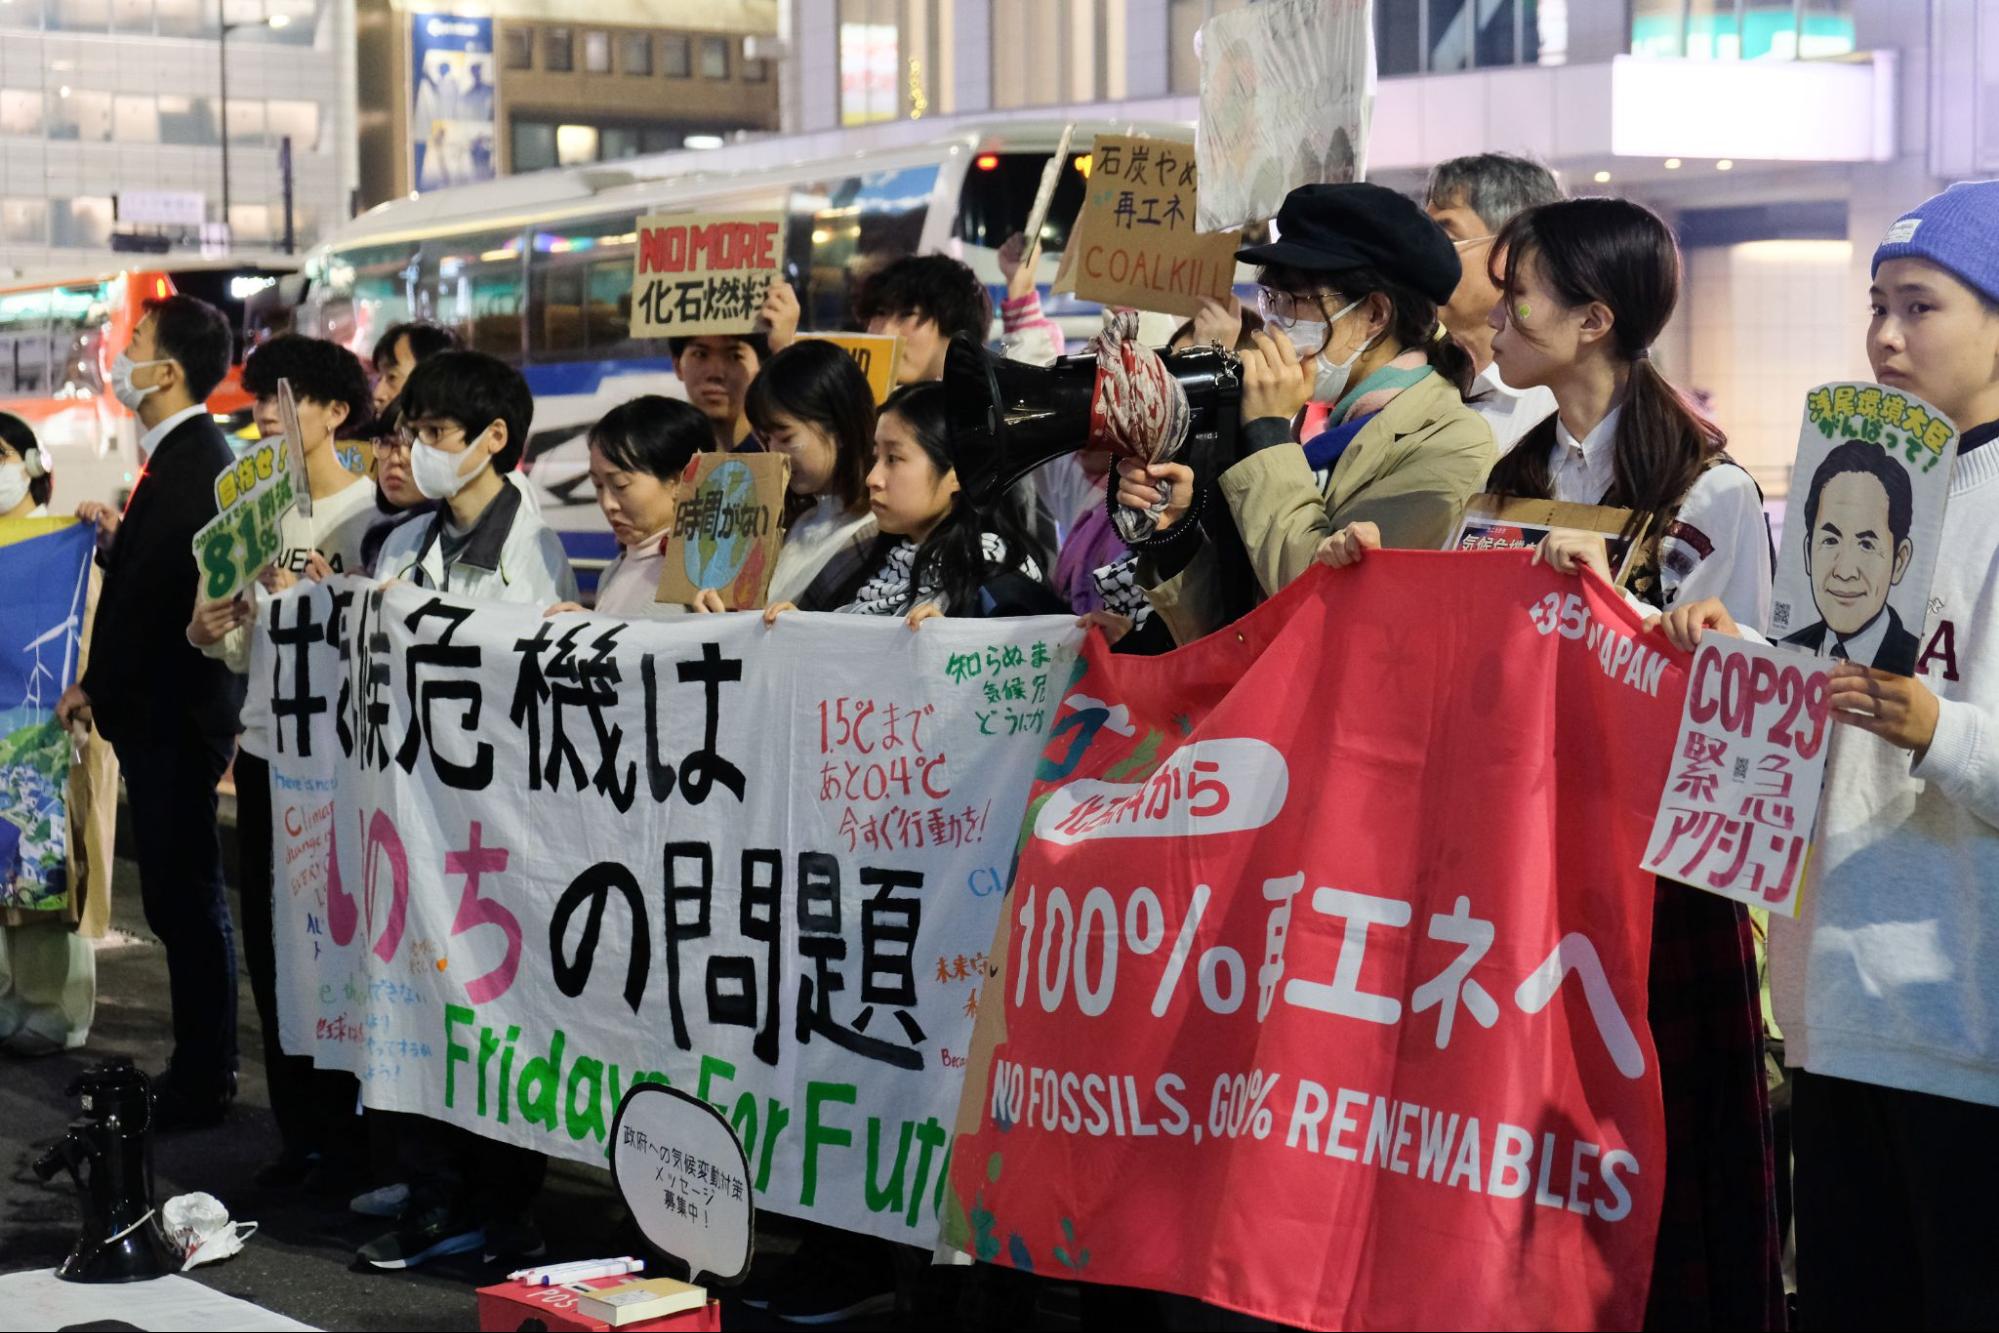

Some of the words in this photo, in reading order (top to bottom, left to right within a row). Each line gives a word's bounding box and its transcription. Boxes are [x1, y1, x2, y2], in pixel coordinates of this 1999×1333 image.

[639, 226, 687, 274] NO
[688, 221, 779, 272] MORE
[1113, 190, 1196, 232] 再エネ
[638, 275, 772, 325] 化石燃料
[1807, 385, 1954, 457] 浅尾環境大臣
[673, 488, 769, 541] 時間がない
[1689, 645, 1831, 761] COP29
[1672, 730, 1795, 830] 緊急
[1649, 805, 1805, 904] アクション
[444, 1003, 671, 1159] Friday
[799, 1080, 954, 1228] Fut
[991, 1059, 1025, 1124] NO
[1027, 1066, 1203, 1146] FOSSILS,
[1284, 1079, 1640, 1223] RENEWABLES
[623, 1125, 744, 1202] 政府への気候変動対策
[655, 1166, 716, 1206] メッセージ
